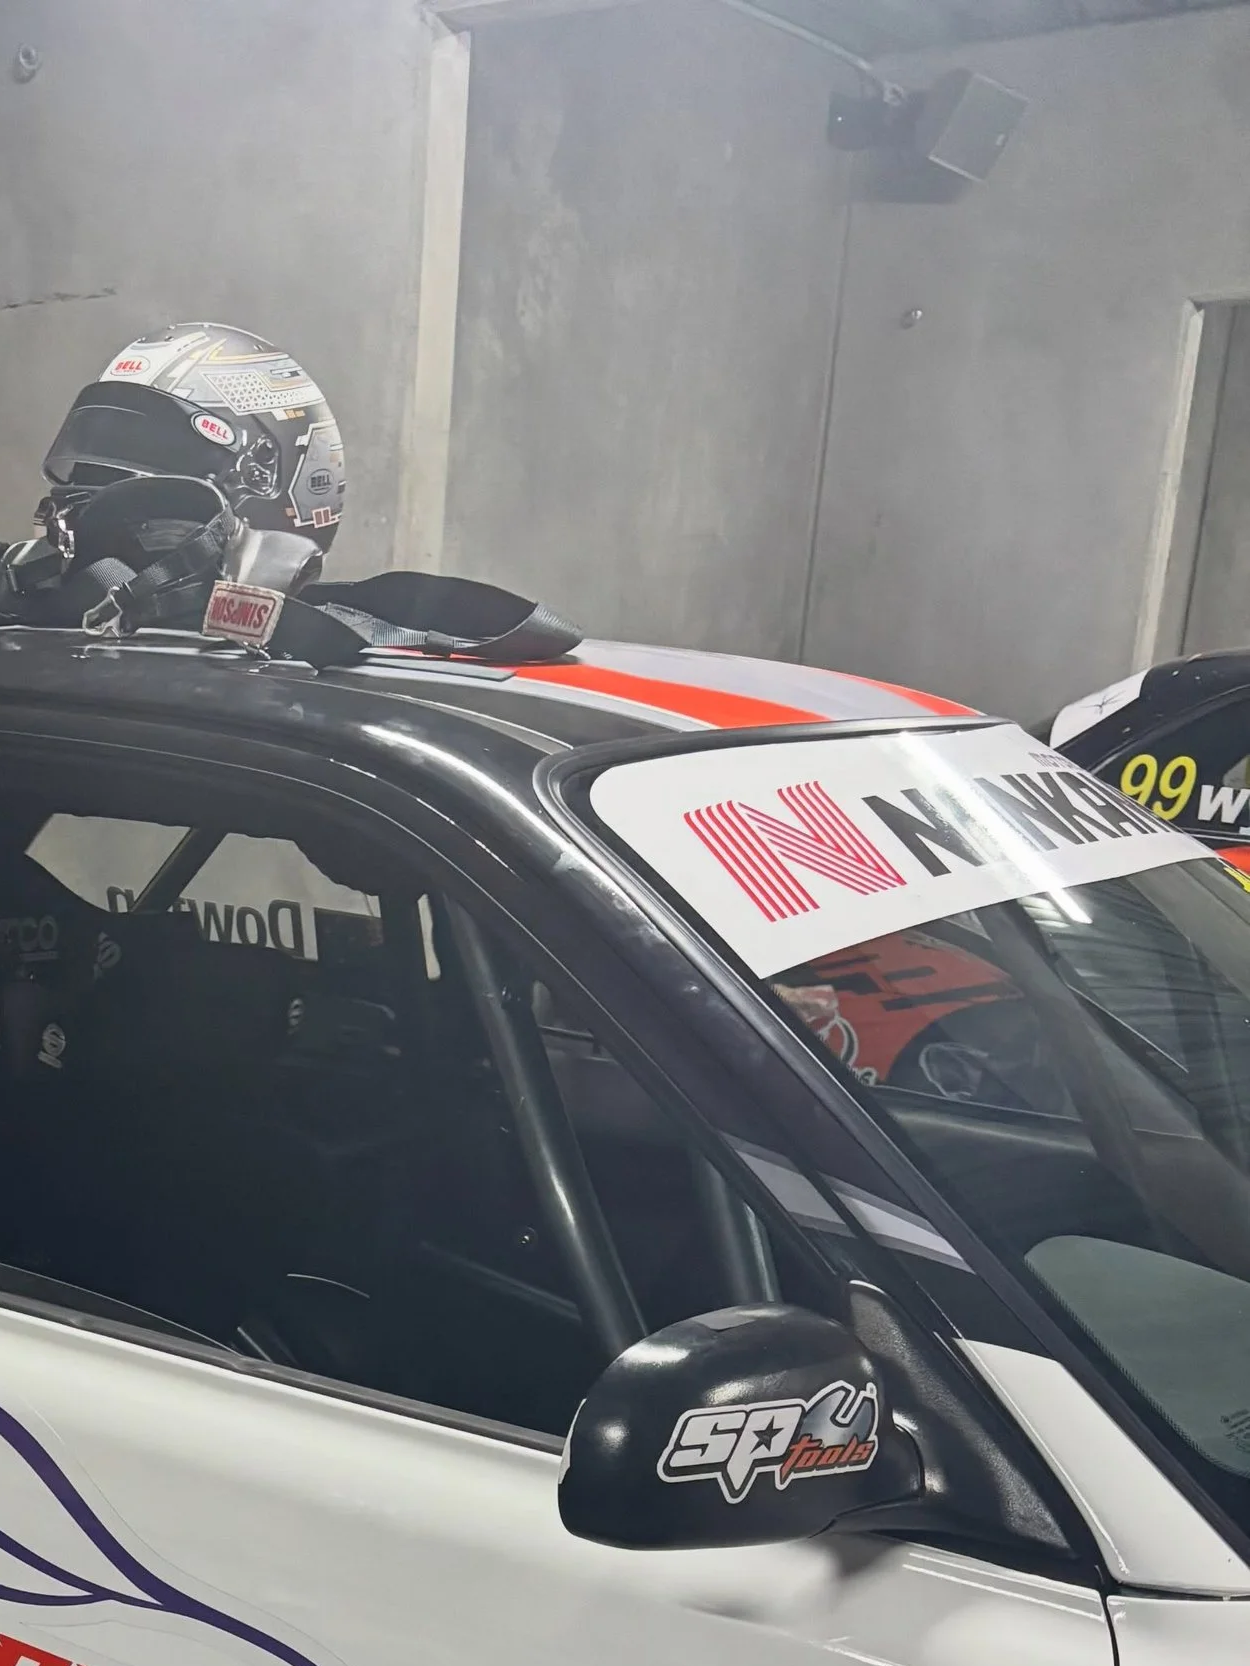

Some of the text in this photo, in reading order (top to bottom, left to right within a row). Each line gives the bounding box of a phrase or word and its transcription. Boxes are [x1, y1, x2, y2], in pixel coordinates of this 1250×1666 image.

[115, 360, 143, 371] BELL
[201, 418, 229, 441] BELL
[310, 474, 332, 488] BELL
[210, 596, 269, 629] SIMPSON
[1120, 754, 1198, 821] 99
[669, 1406, 873, 1491] SP tools
